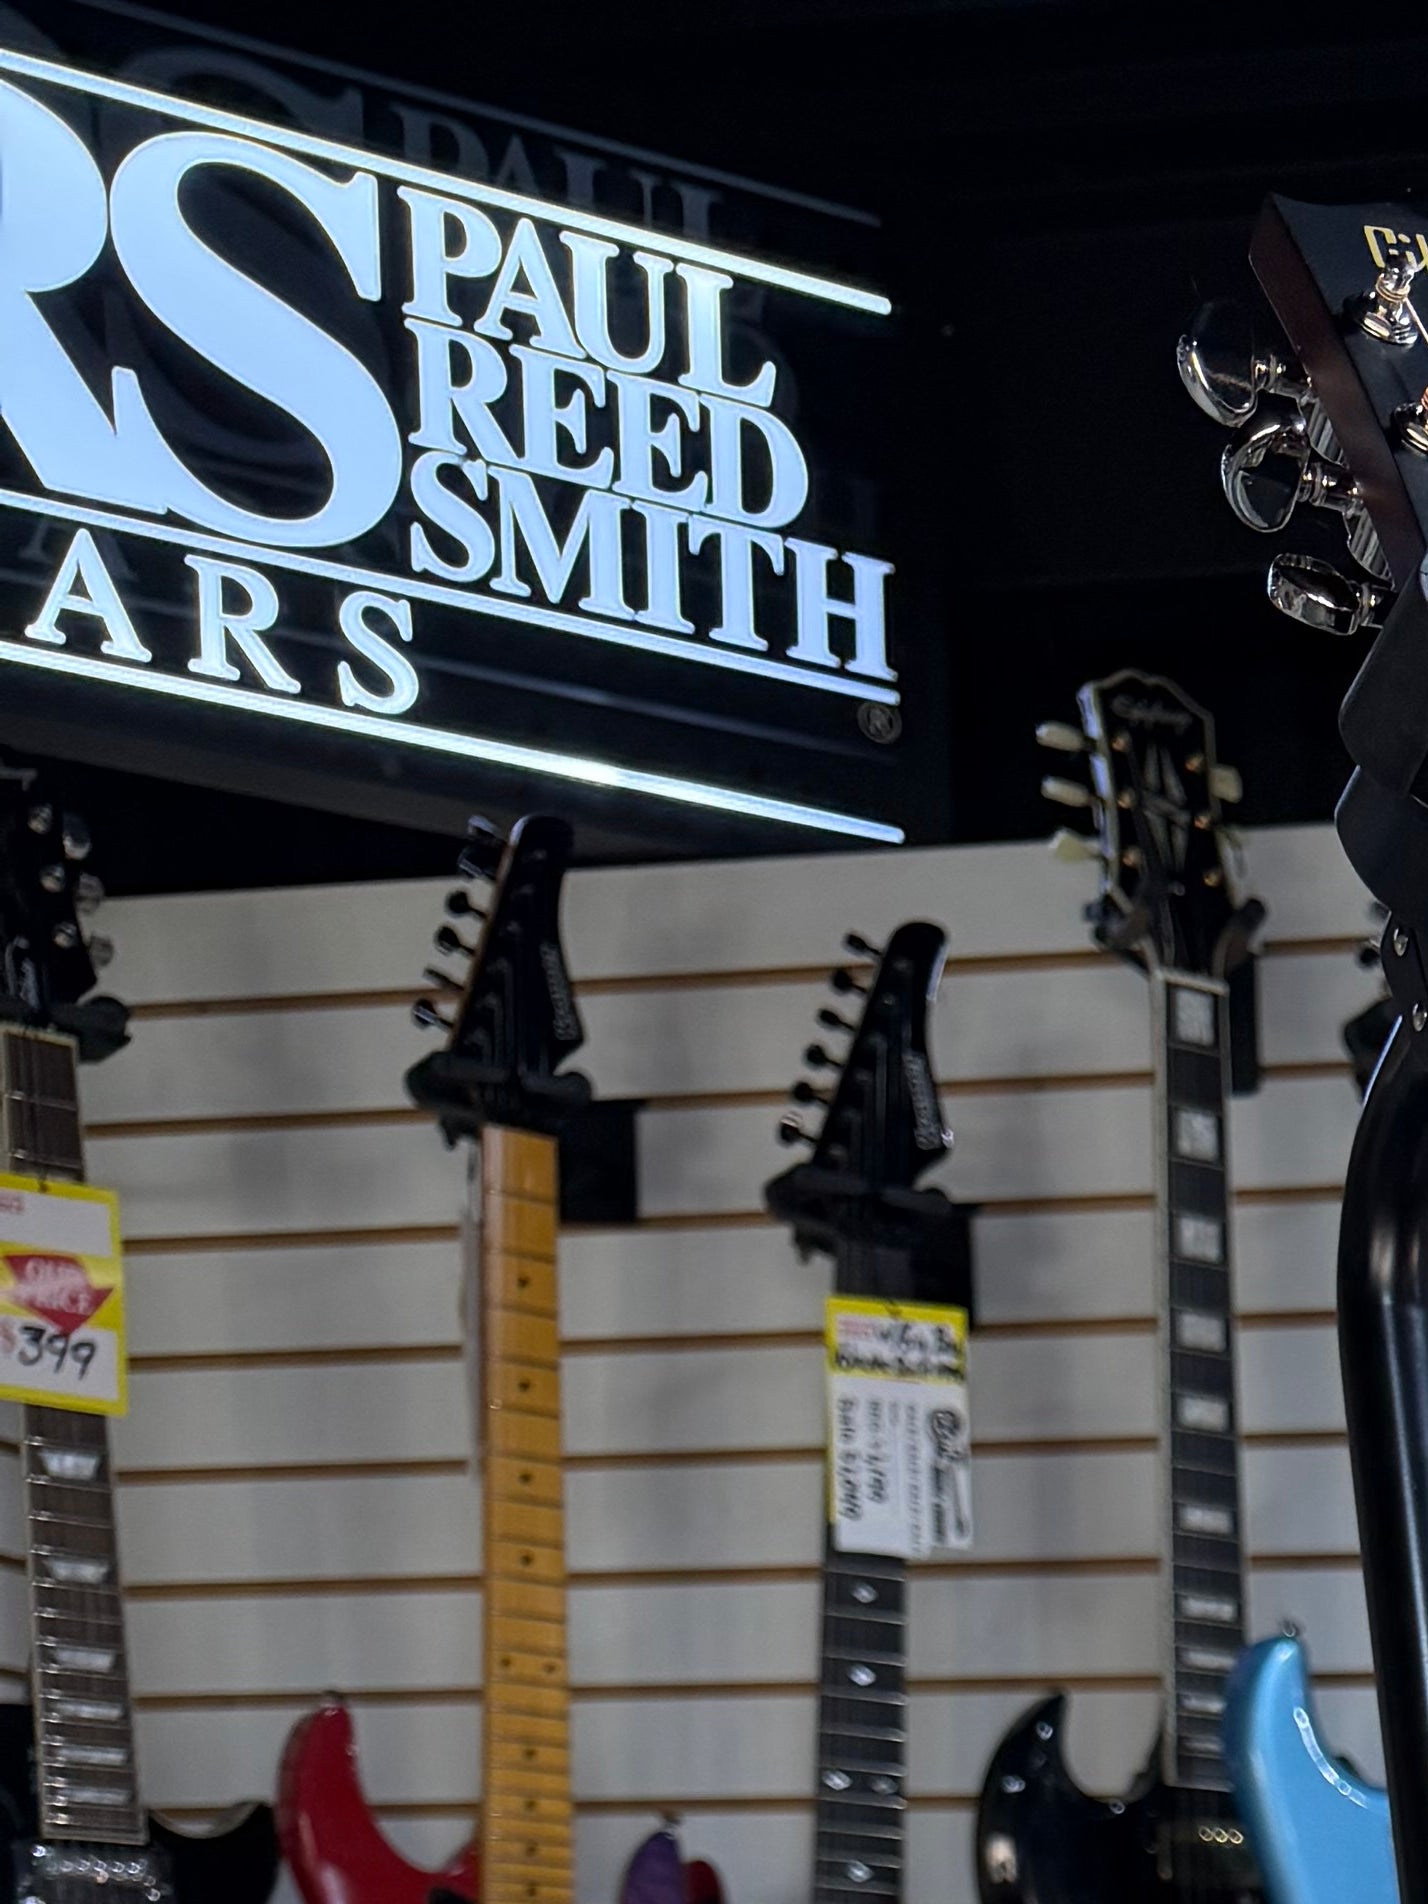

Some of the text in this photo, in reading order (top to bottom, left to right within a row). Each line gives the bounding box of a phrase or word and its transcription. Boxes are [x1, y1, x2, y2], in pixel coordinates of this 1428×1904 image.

[397, 185, 777, 408] PAUL
[402, 316, 809, 532] REED
[409, 450, 899, 682] SMITH
